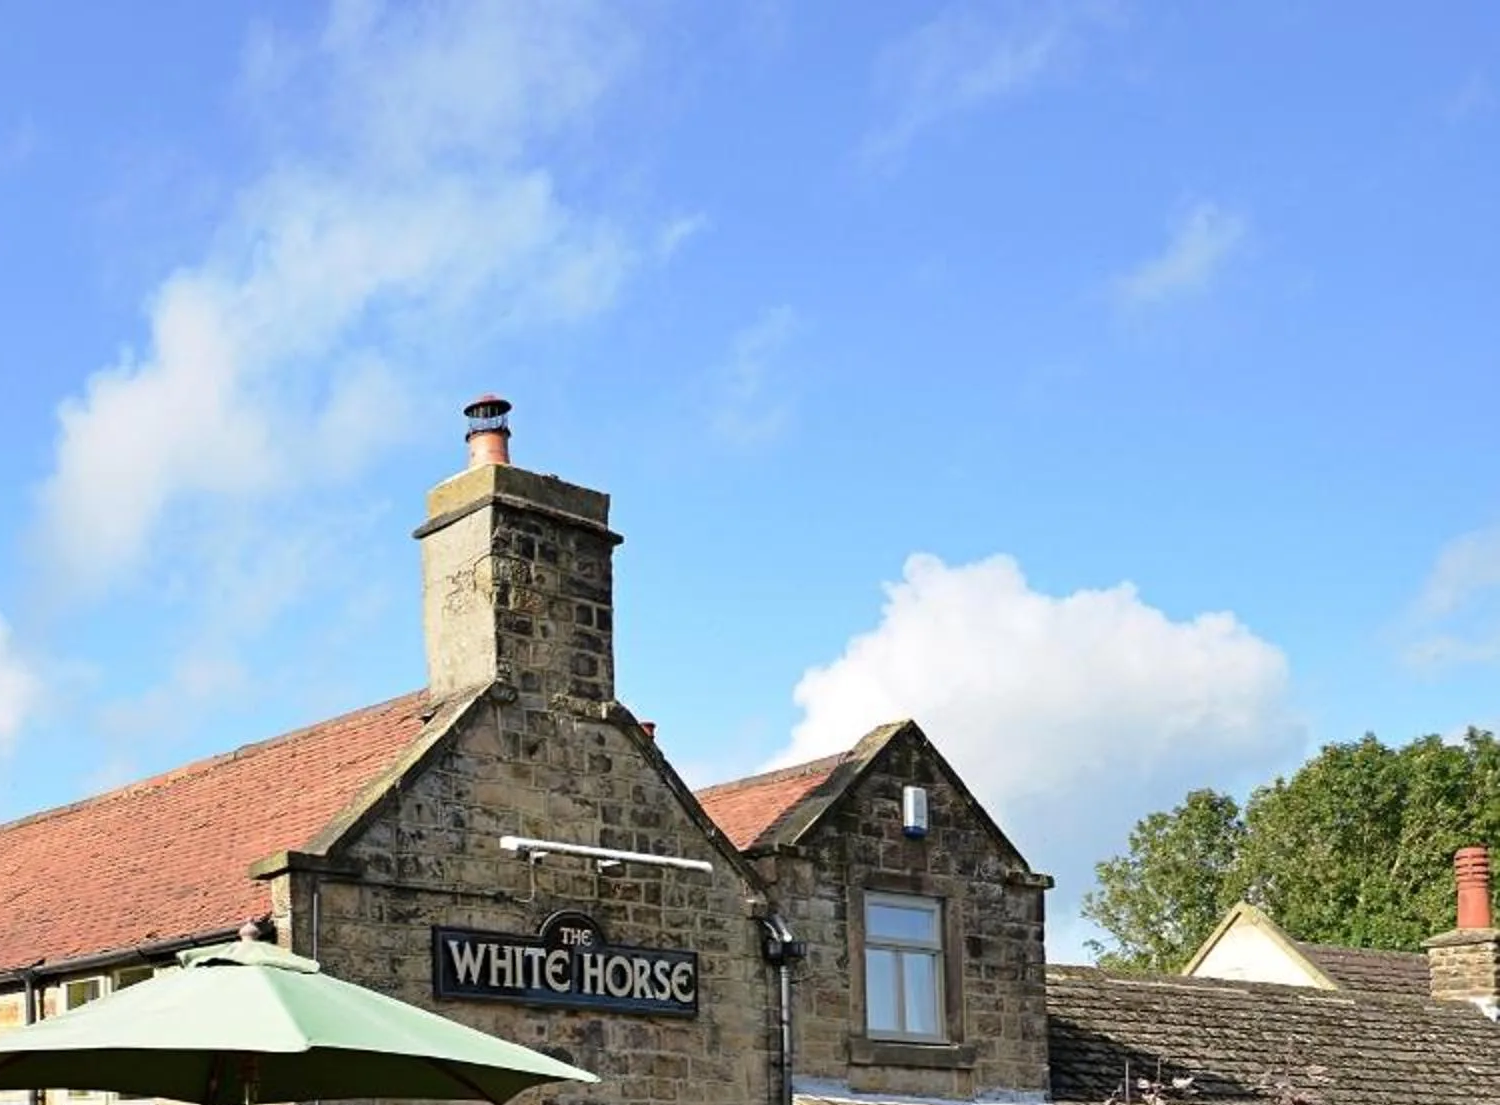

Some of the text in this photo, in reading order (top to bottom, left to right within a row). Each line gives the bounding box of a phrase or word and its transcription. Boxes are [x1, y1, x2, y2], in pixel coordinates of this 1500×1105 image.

[560, 927, 593, 946] THE
[448, 940, 695, 1003] WHITE HORSE
